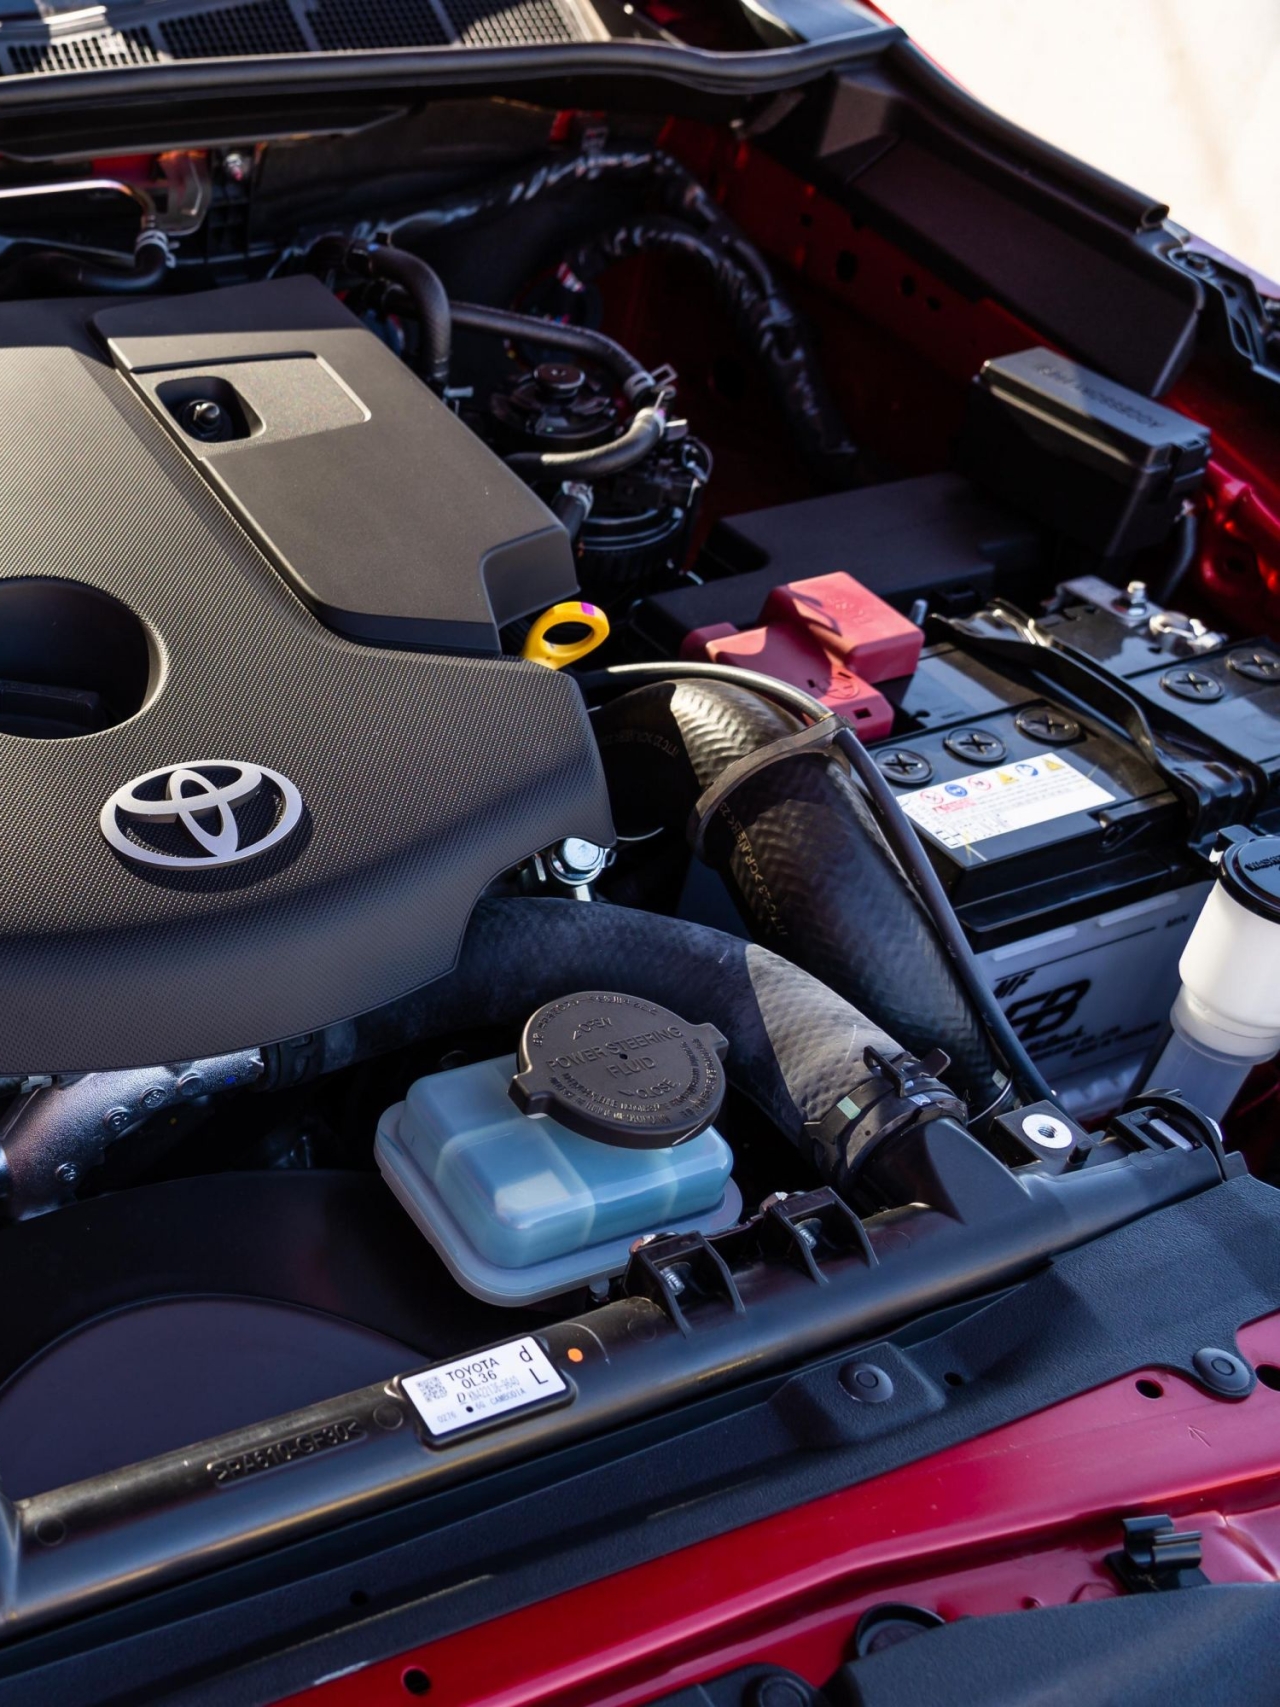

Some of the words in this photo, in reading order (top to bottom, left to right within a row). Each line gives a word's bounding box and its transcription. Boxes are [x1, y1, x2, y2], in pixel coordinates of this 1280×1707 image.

[578, 1017, 613, 1033] OPEN
[546, 1046, 607, 1073] POWER
[605, 1026, 684, 1055] STEERING
[607, 1055, 657, 1079] FLUID
[635, 1077, 676, 1099] CLOSE
[519, 1345, 533, 1363] d
[446, 1357, 500, 1382] TOYOTA
[528, 1368, 549, 1386] L
